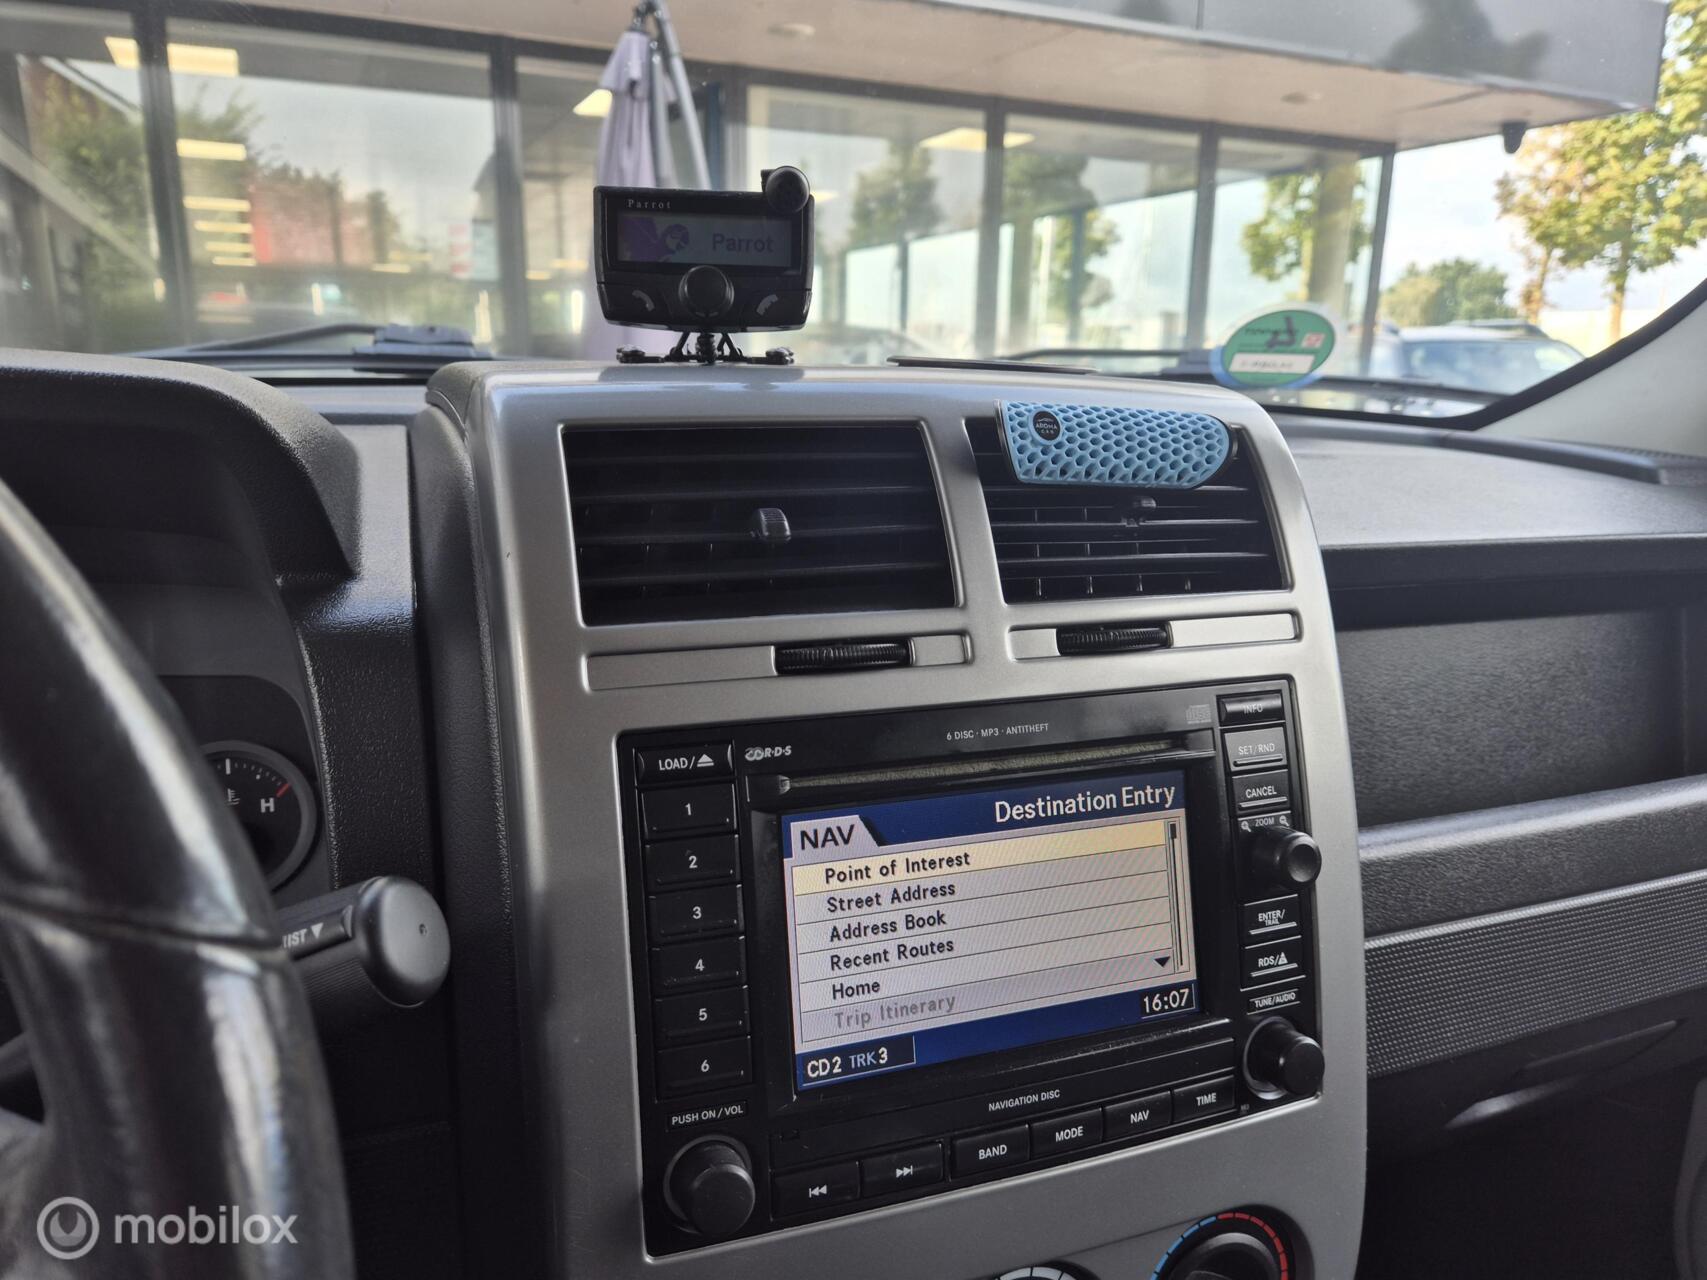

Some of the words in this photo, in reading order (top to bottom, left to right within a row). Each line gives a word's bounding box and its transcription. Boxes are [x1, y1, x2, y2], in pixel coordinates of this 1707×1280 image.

[628, 199, 672, 209] Parrot
[712, 233, 774, 253] Parrot
[1243, 703, 1264, 714] INFO
[946, 733, 953, 741] 6
[954, 730, 975, 741] DISC
[981, 727, 1000, 738] MP3
[1006, 722, 1050, 736] ANTITHEFT
[1238, 742, 1276, 756] SET/RND
[1245, 785, 1278, 799] CANCEL
[261, 798, 275, 813] H
[685, 803, 693, 816] 1
[995, 791, 1117, 823] Destination
[1121, 784, 1176, 809] Entry
[1255, 817, 1275, 828] ZOOM
[800, 823, 855, 851] NAV
[688, 855, 698, 869] 2
[825, 865, 872, 885] Point
[879, 859, 898, 877] of
[905, 851, 971, 874] Interest
[826, 892, 883, 914] Street
[890, 882, 957, 905] Address
[692, 906, 702, 920] 3
[829, 920, 898, 943] Address
[904, 909, 948, 931] Book
[829, 948, 891, 972] Recent
[897, 940, 955, 961] Routes
[695, 958, 705, 972] 4
[831, 981, 882, 1001] Home
[1143, 987, 1190, 1014] 16:07
[1254, 992, 1296, 1009] TUNE/AUDIO
[698, 1008, 708, 1022] 5
[834, 1010, 872, 1030] Trip
[879, 995, 957, 1022] Itinerary
[700, 1060, 710, 1073] 6
[988, 1094, 1040, 1113] NAVIGATION
[1040, 1089, 1061, 1102] DISC
[1196, 1092, 1217, 1107] TIME
[672, 1112, 700, 1126] PUSH
[1130, 1109, 1150, 1125] NAV
[1055, 1125, 1084, 1143] MODE
[978, 1143, 1008, 1161] BAND
